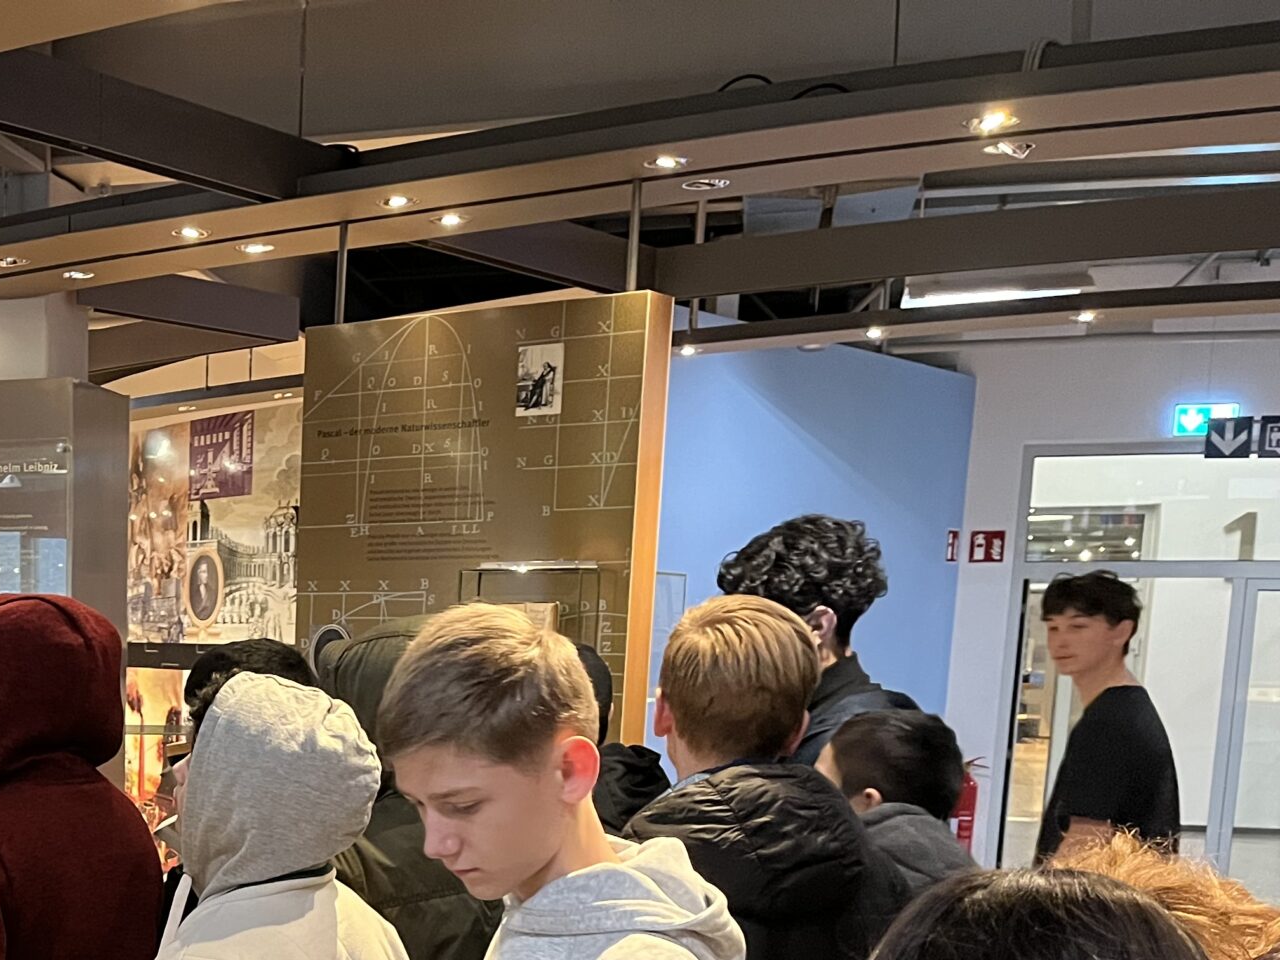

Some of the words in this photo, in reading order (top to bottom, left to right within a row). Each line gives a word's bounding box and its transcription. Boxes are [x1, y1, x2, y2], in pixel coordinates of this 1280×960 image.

[429, 344, 438, 355] R
[413, 377, 422, 386] D
[427, 399, 437, 409] R
[592, 409, 604, 421] X
[317, 429, 342, 439] Pascal
[363, 425, 399, 436] moderne
[401, 419, 491, 434] Naturwissenschaftler
[412, 444, 421, 454] D
[424, 442, 435, 452] X
[543, 455, 553, 465] G
[23, 461, 58, 472] Leibniz
[424, 473, 433, 484] R
[541, 505, 551, 516] B
[1223, 512, 1258, 561] 1
[307, 581, 318, 591] X
[339, 580, 351, 591] X
[378, 580, 390, 590] X
[420, 578, 429, 589] B
[427, 594, 435, 605] S
[599, 599, 607, 610] B
[332, 609, 341, 620] D
[301, 638, 310, 648] D
